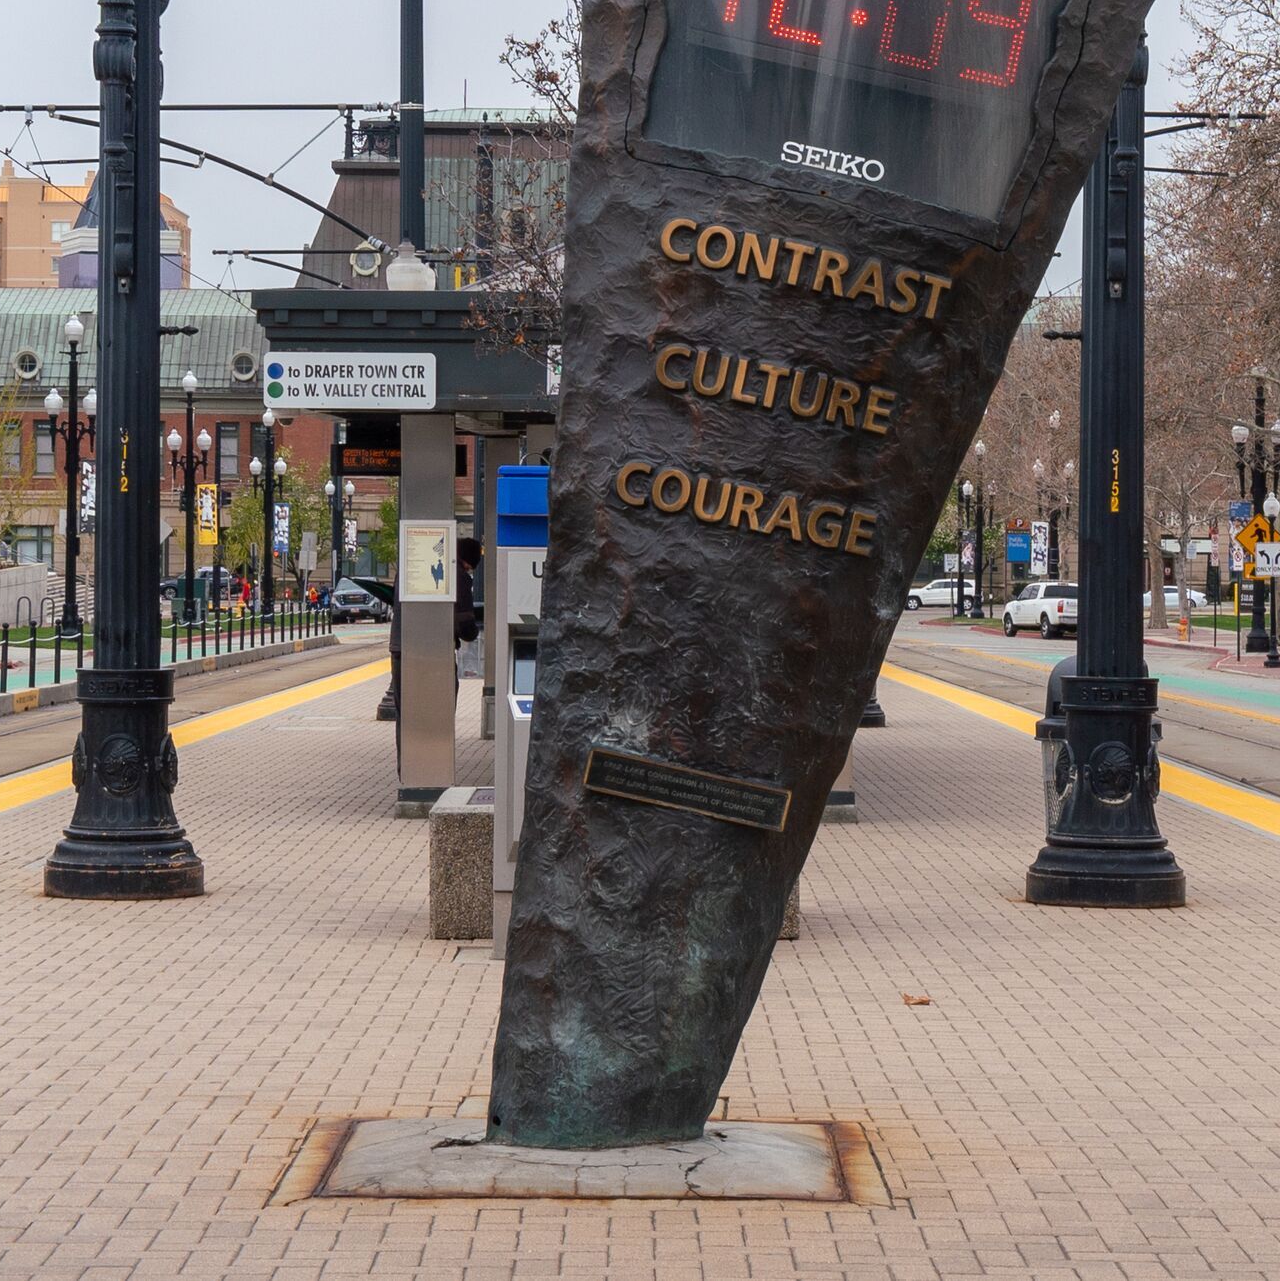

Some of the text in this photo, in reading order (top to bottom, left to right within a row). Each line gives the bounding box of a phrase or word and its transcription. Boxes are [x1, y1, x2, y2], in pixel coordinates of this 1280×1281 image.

[779, 140, 885, 182] SEIKO
[660, 217, 952, 319] CONTRAST
[287, 383, 426, 398] to W. VALLEY CENTRAL
[288, 364, 425, 379] to DRAPER TOWN CTR
[655, 344, 898, 436] CULTURE
[616, 461, 878, 557] COURAGE
